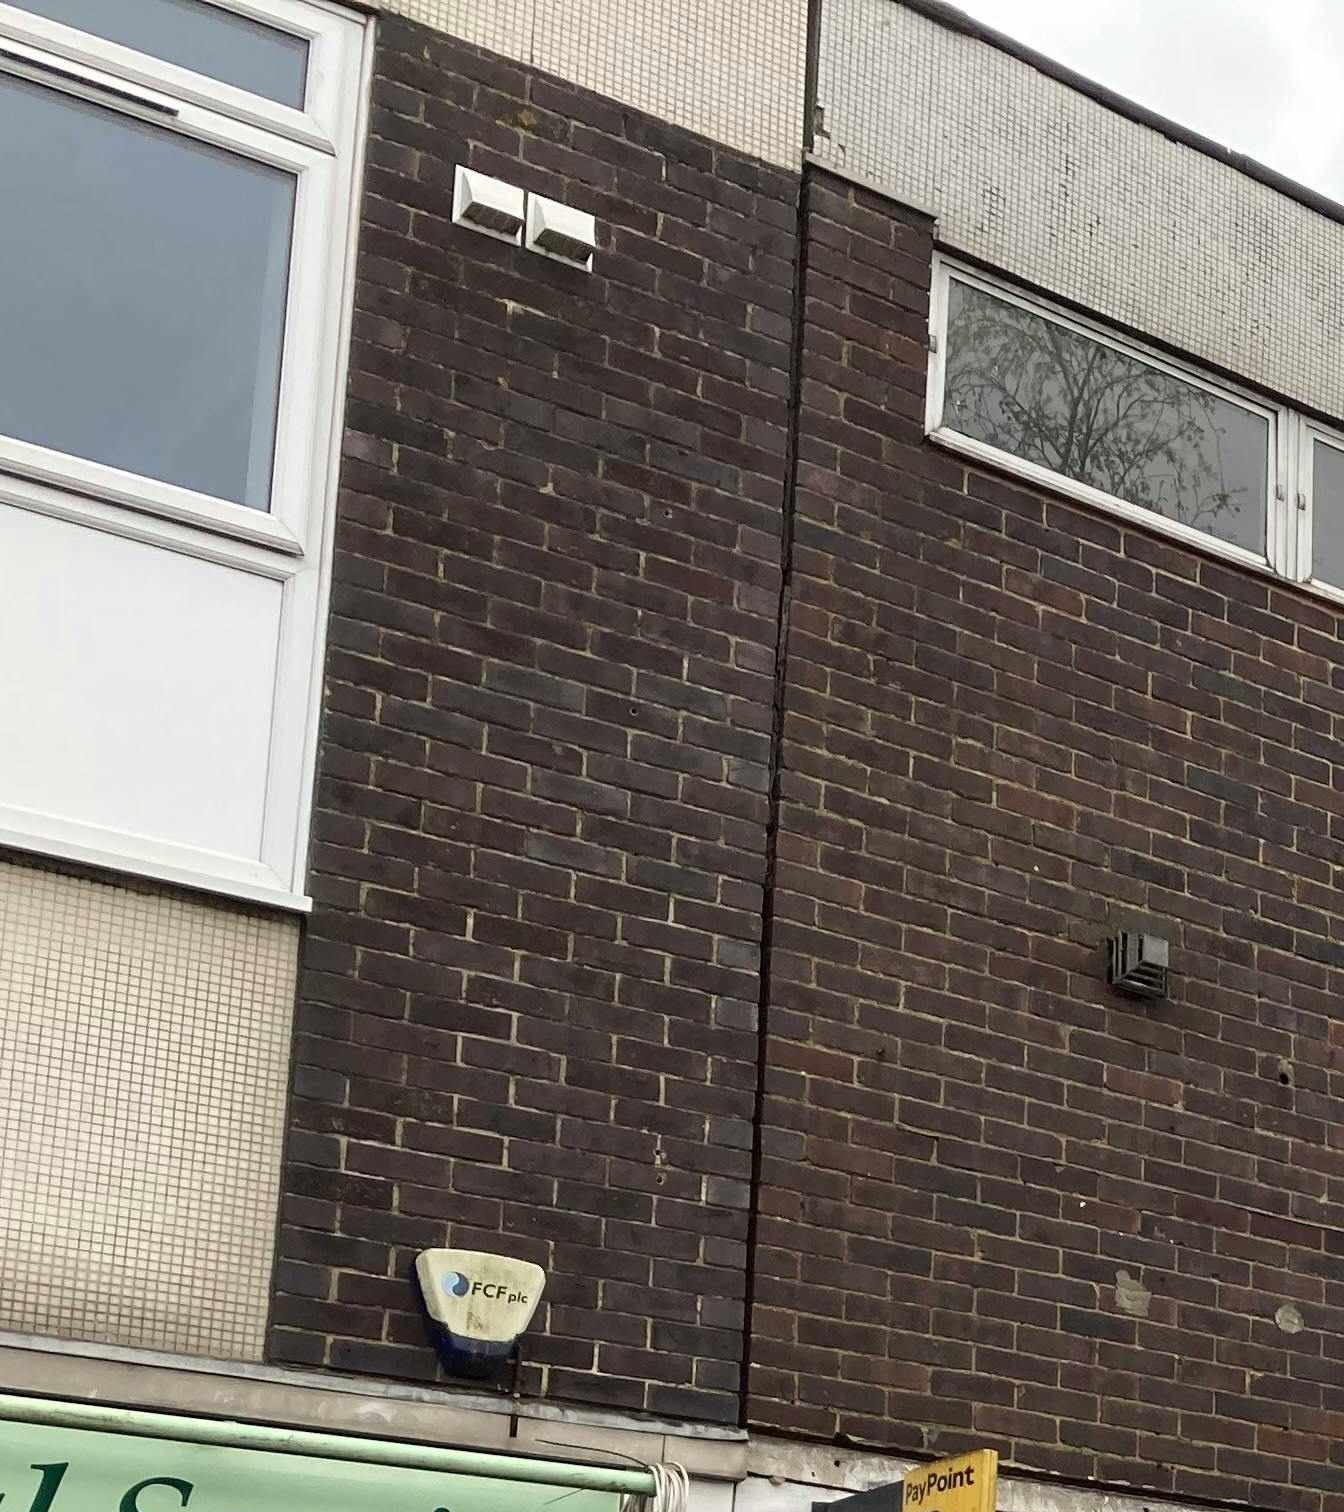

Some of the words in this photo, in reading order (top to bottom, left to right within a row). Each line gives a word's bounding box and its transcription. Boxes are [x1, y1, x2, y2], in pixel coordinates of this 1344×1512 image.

[472, 1281, 507, 1300] FCF
[508, 1290, 529, 1304] plc
[905, 1465, 975, 1505] PayPoint
